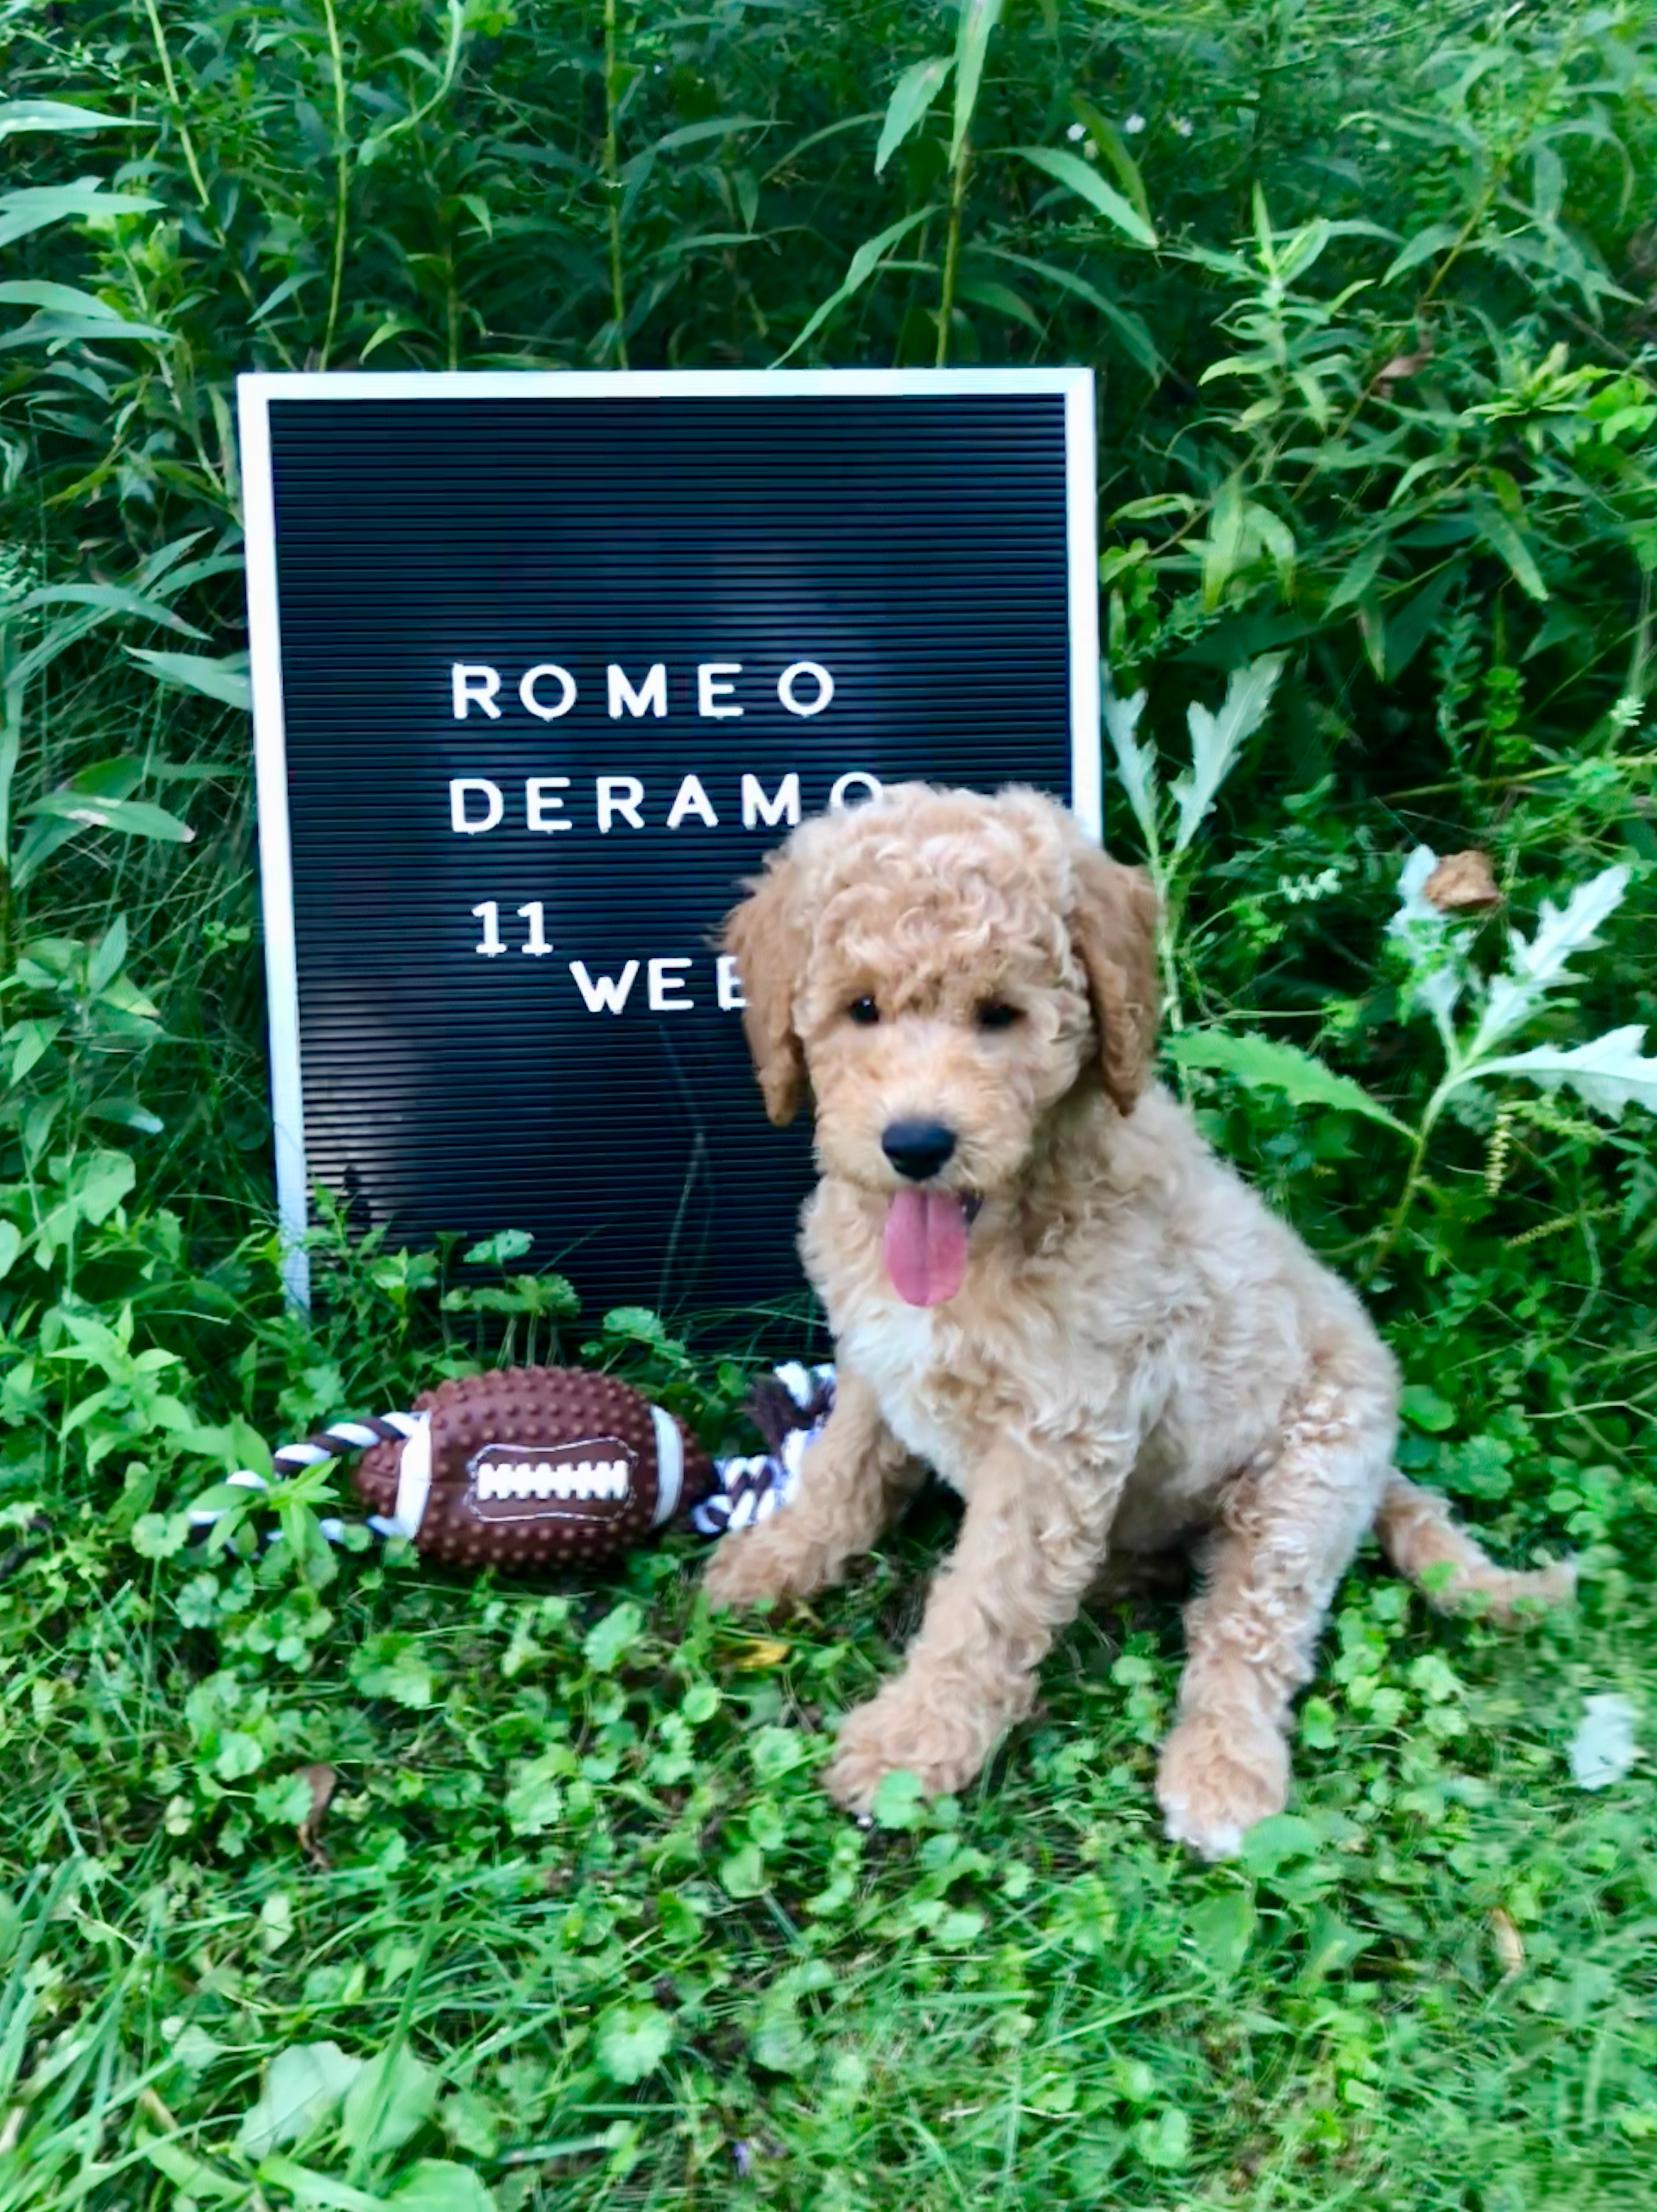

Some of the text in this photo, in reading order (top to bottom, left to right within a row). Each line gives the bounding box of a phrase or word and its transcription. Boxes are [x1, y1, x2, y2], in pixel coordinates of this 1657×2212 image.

[452, 662, 834, 720] ROMEO
[449, 771, 883, 834] DERAMO
[472, 901, 553, 957] 11
